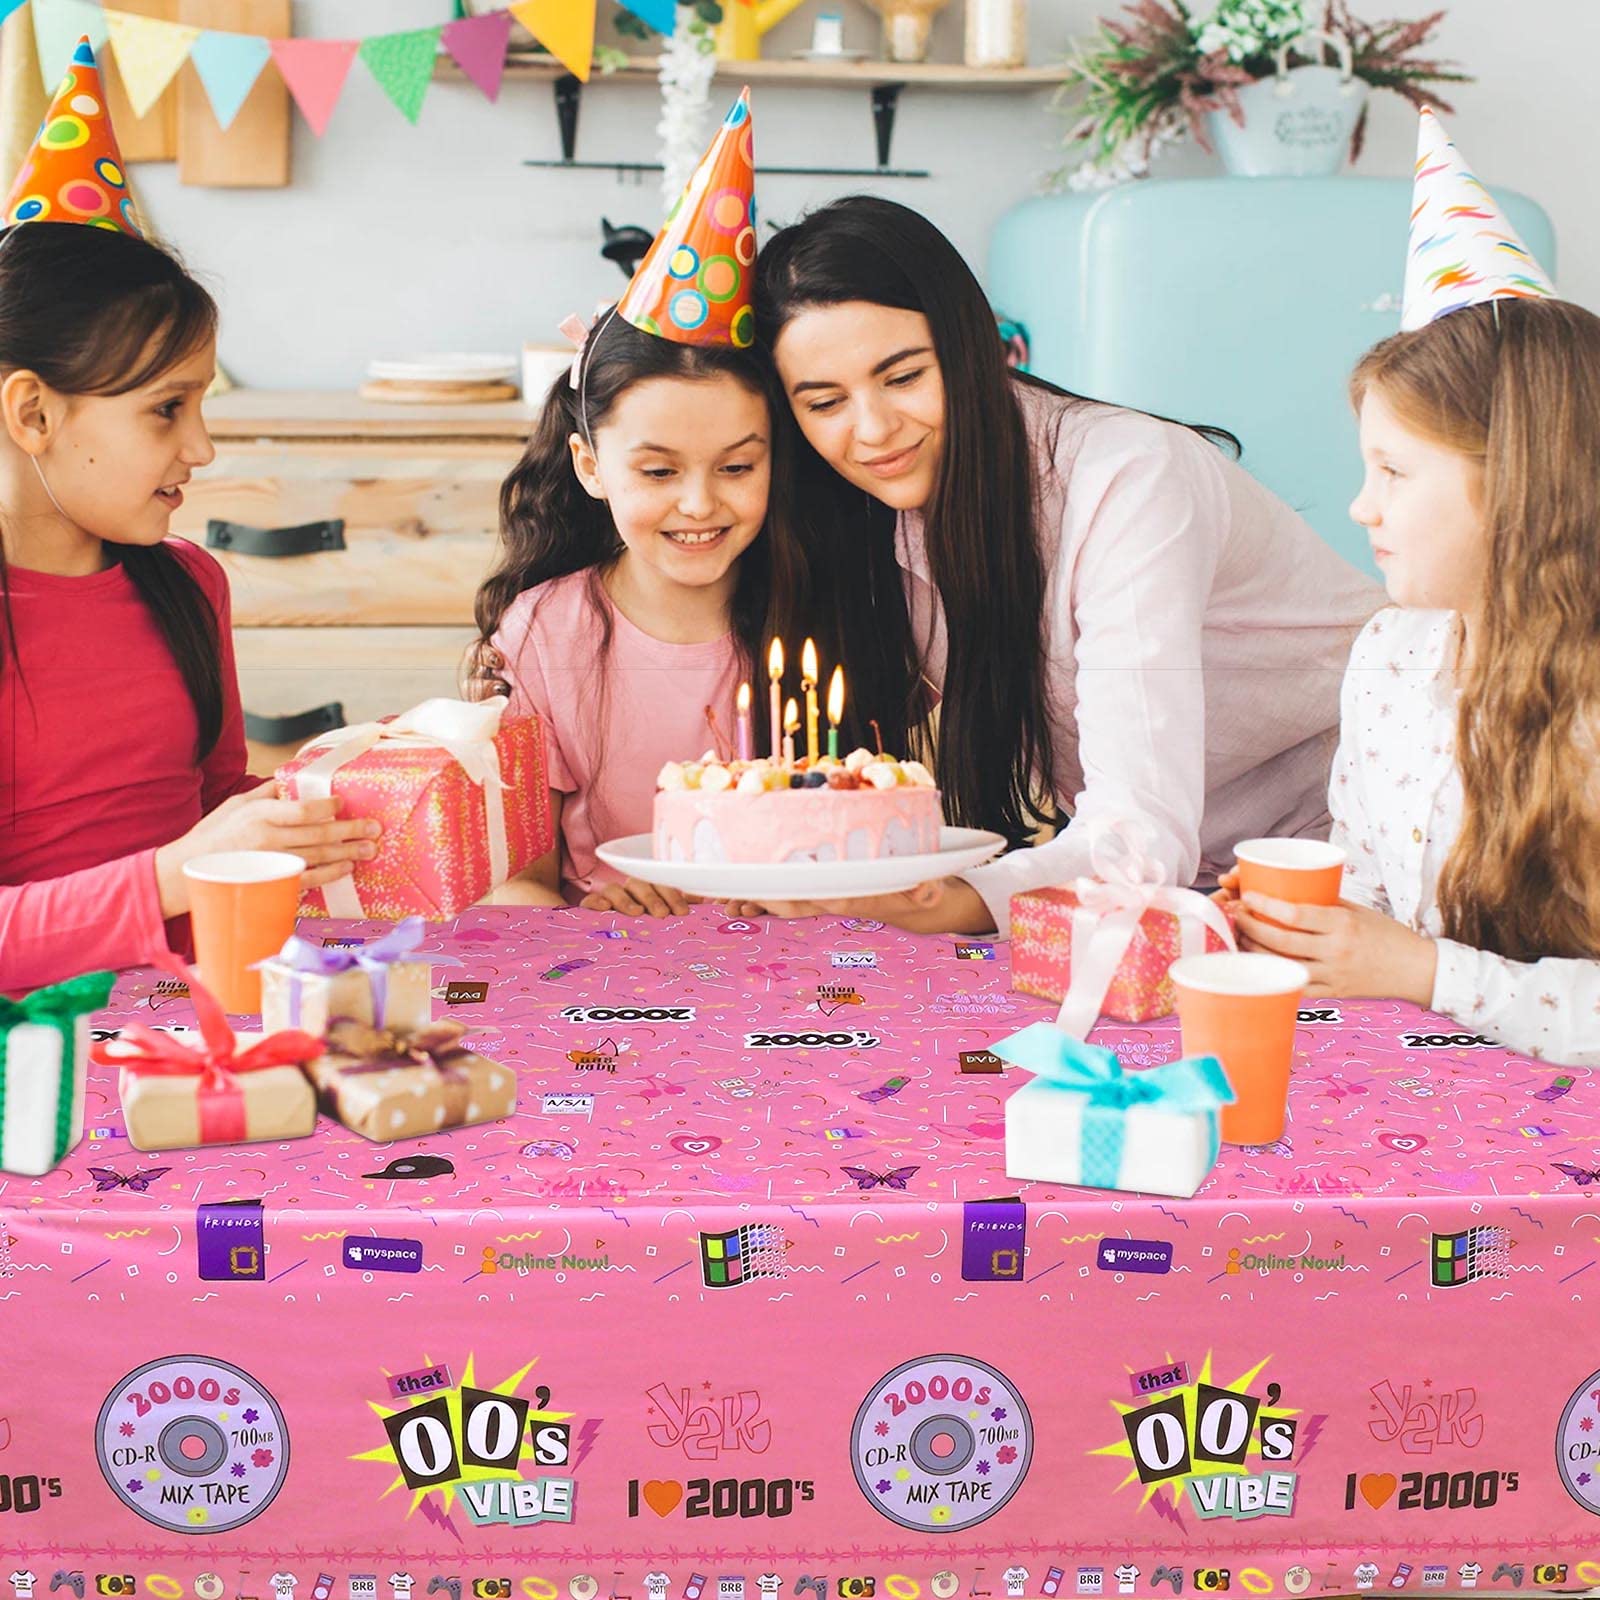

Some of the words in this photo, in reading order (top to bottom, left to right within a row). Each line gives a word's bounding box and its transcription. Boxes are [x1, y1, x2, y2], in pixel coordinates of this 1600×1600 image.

[449, 991, 481, 1000] DVD
[749, 1032, 878, 1047] 2000's
[965, 1055, 998, 1064] DVD
[546, 1099, 592, 1107] A/S/L
[203, 1215, 261, 1229] FRIENDS
[969, 1220, 1024, 1233] FRIENDS
[362, 1245, 418, 1262] myspace
[499, 1252, 557, 1269] Online
[561, 1253, 610, 1270] Now!
[1116, 1248, 1168, 1264] myspace
[1243, 1254, 1297, 1270] Online
[1301, 1253, 1346, 1270] Now!
[396, 1369, 445, 1393] that
[1136, 1367, 1183, 1391] that
[126, 1376, 241, 1418] 2000s
[883, 1375, 992, 1417] 2000s
[112, 1445, 156, 1467] CD-R
[864, 1443, 908, 1468] CD-R
[1568, 1441, 1600, 1461] CD-
[160, 1484, 195, 1505] MIX
[199, 1482, 250, 1505] TAPE
[461, 1479, 571, 1519] VIBE
[627, 1479, 639, 1518] I
[906, 1482, 940, 1504] MIX
[945, 1480, 993, 1503] TAPE
[1191, 1473, 1293, 1513] VIBE
[1344, 1473, 1357, 1511] I
[1079, 1574, 1101, 1585] BRB
[1424, 1572, 1446, 1582] BRB
[351, 1581, 375, 1592] BRB
[720, 1582, 743, 1593] BRB
